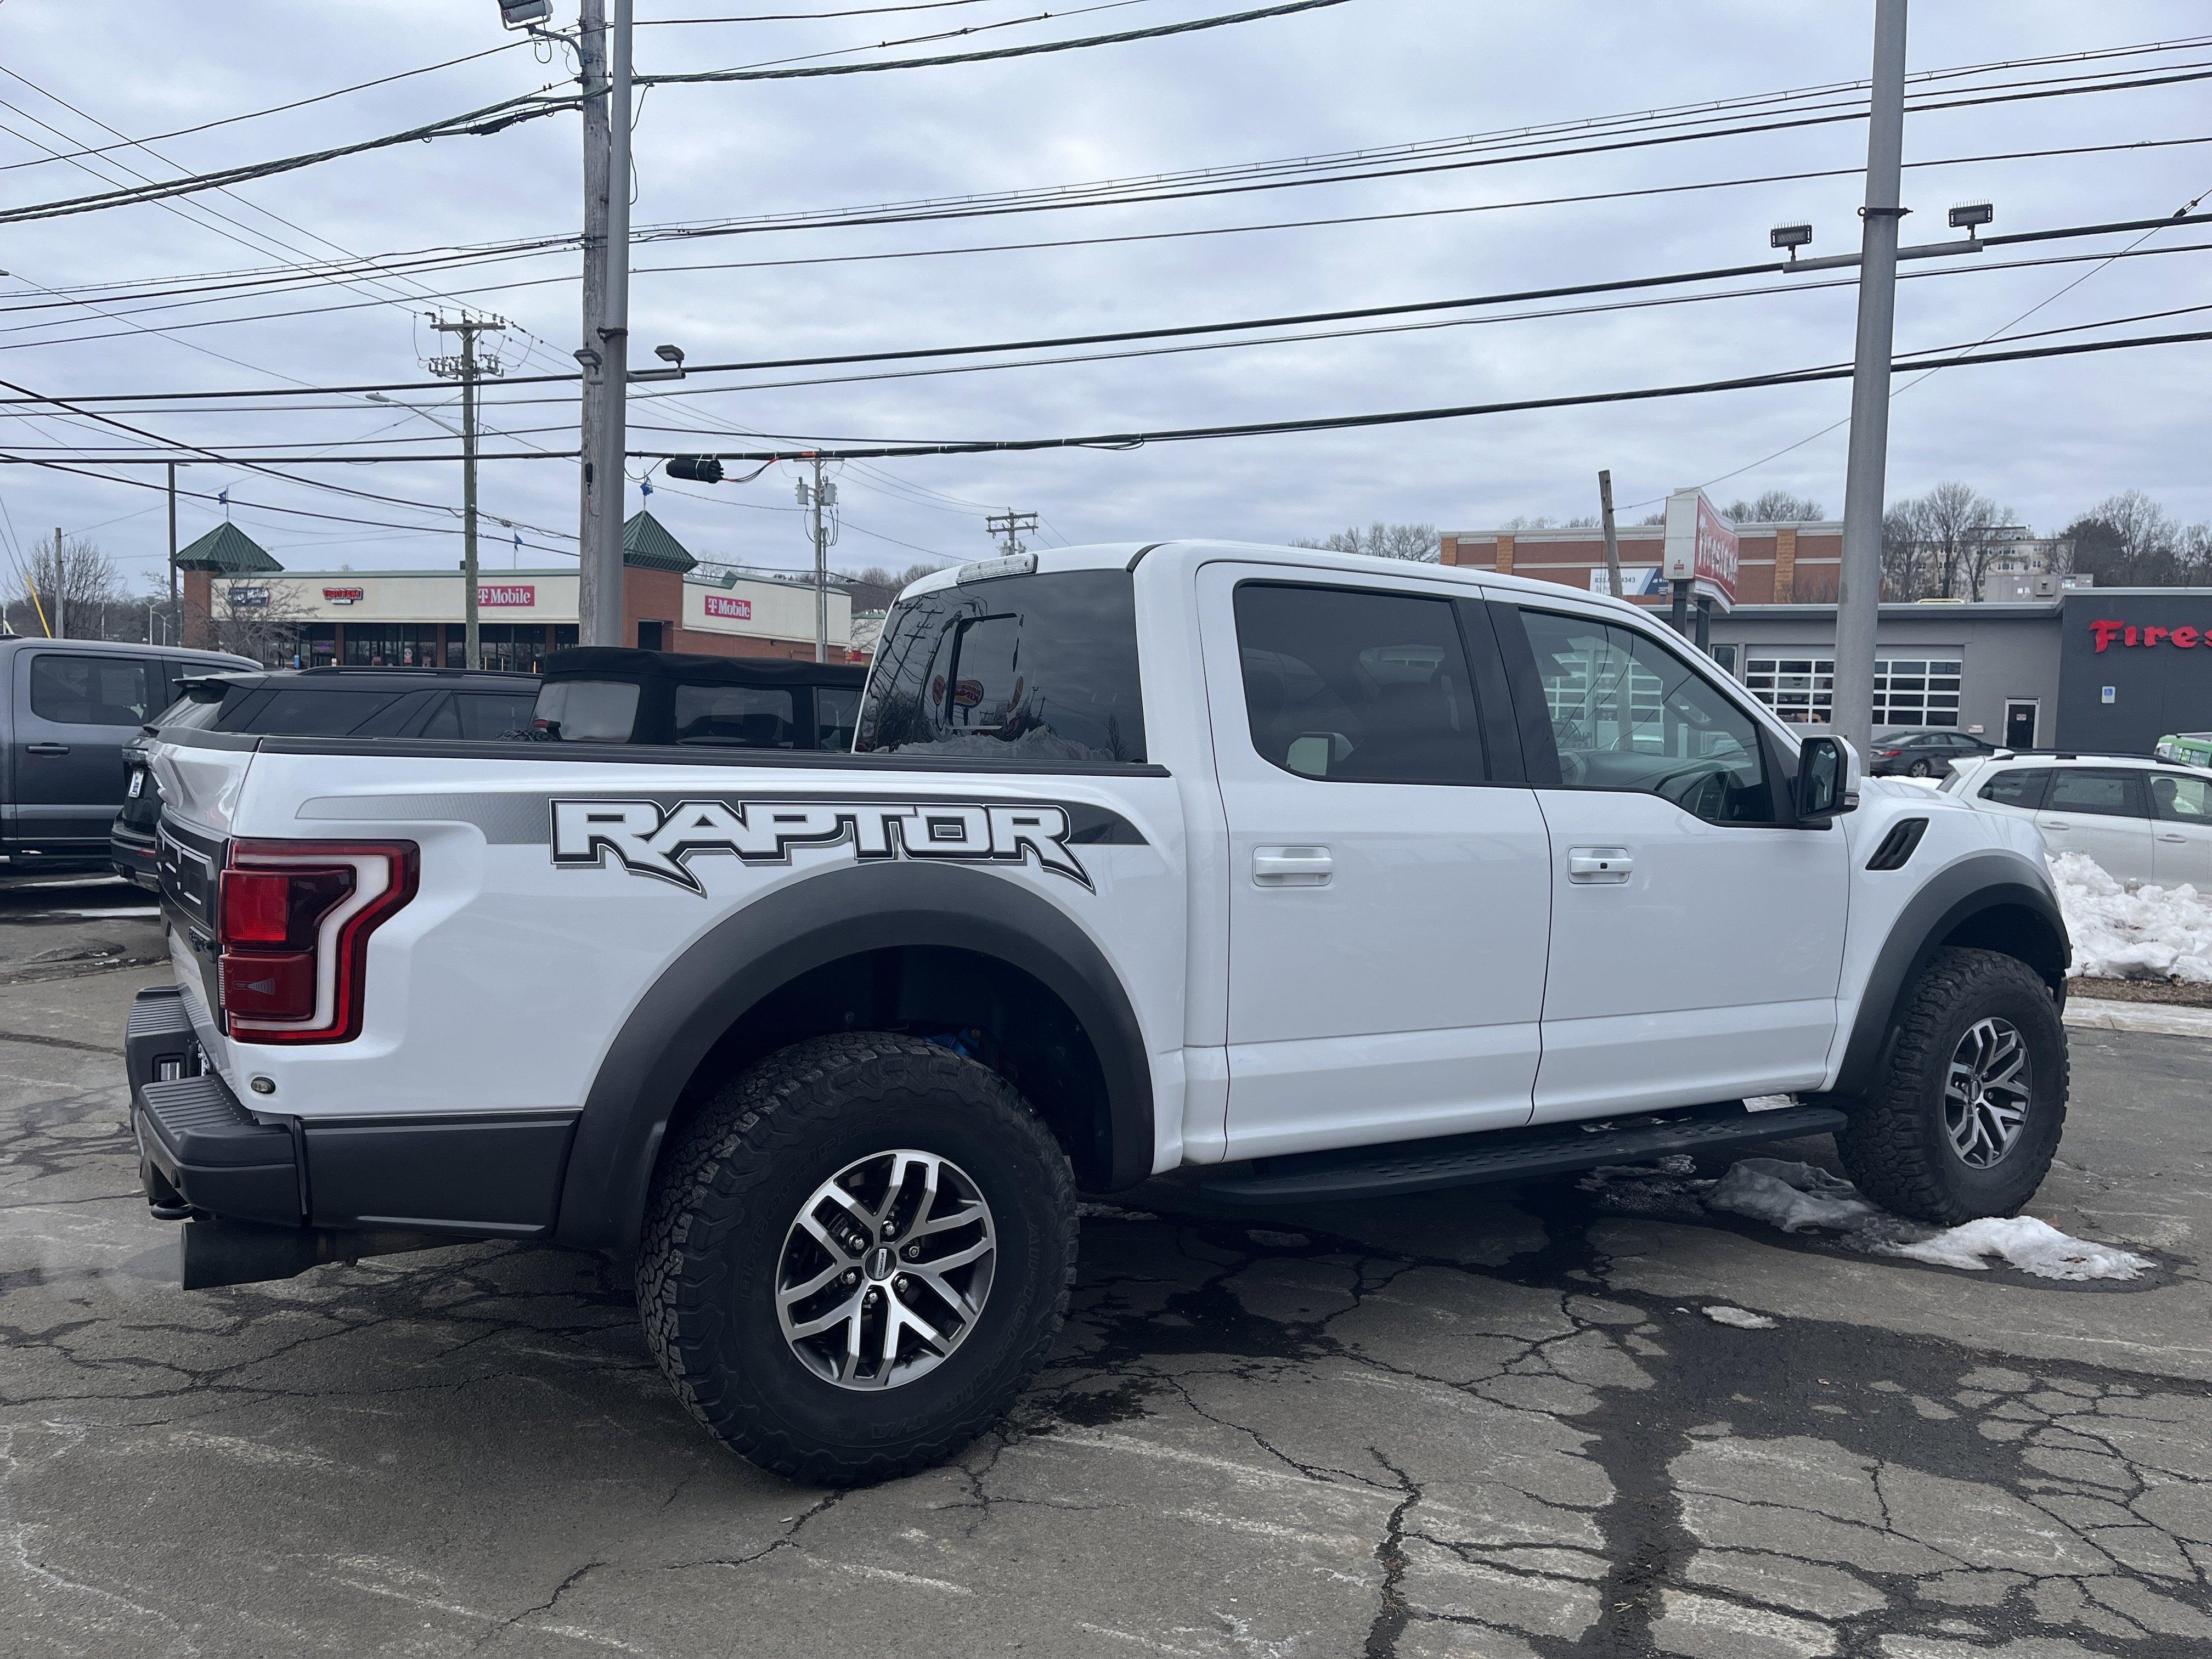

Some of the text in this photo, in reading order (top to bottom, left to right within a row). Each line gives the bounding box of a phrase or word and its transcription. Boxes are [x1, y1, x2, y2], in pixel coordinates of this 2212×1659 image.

[490, 588, 531, 604] Mobile
[718, 599, 750, 618] Mobile
[549, 798, 1096, 898] RAPTOR
